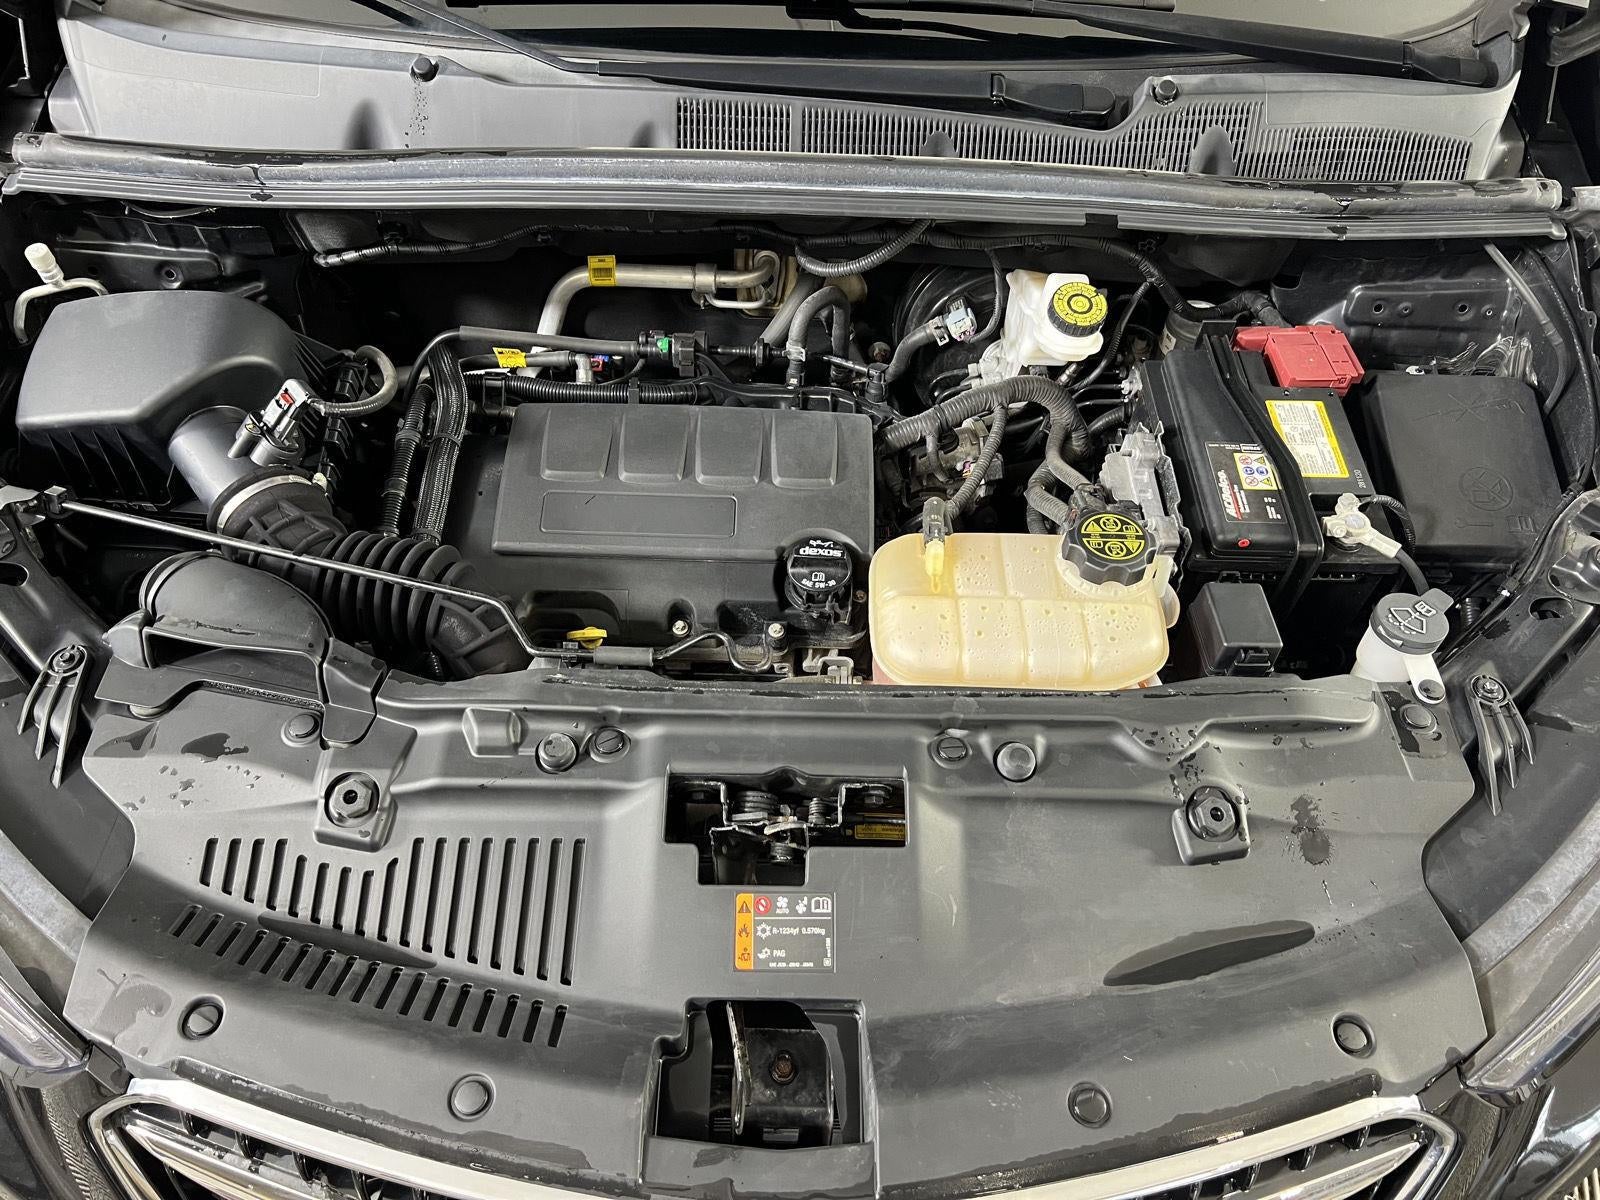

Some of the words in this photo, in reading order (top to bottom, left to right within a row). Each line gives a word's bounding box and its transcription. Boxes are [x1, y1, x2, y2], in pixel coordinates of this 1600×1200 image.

[799, 546, 843, 557] dexos
[772, 926, 799, 936] R-1234yf
[801, 926, 826, 936] 0.570kg
[772, 949, 786, 958] PAG
